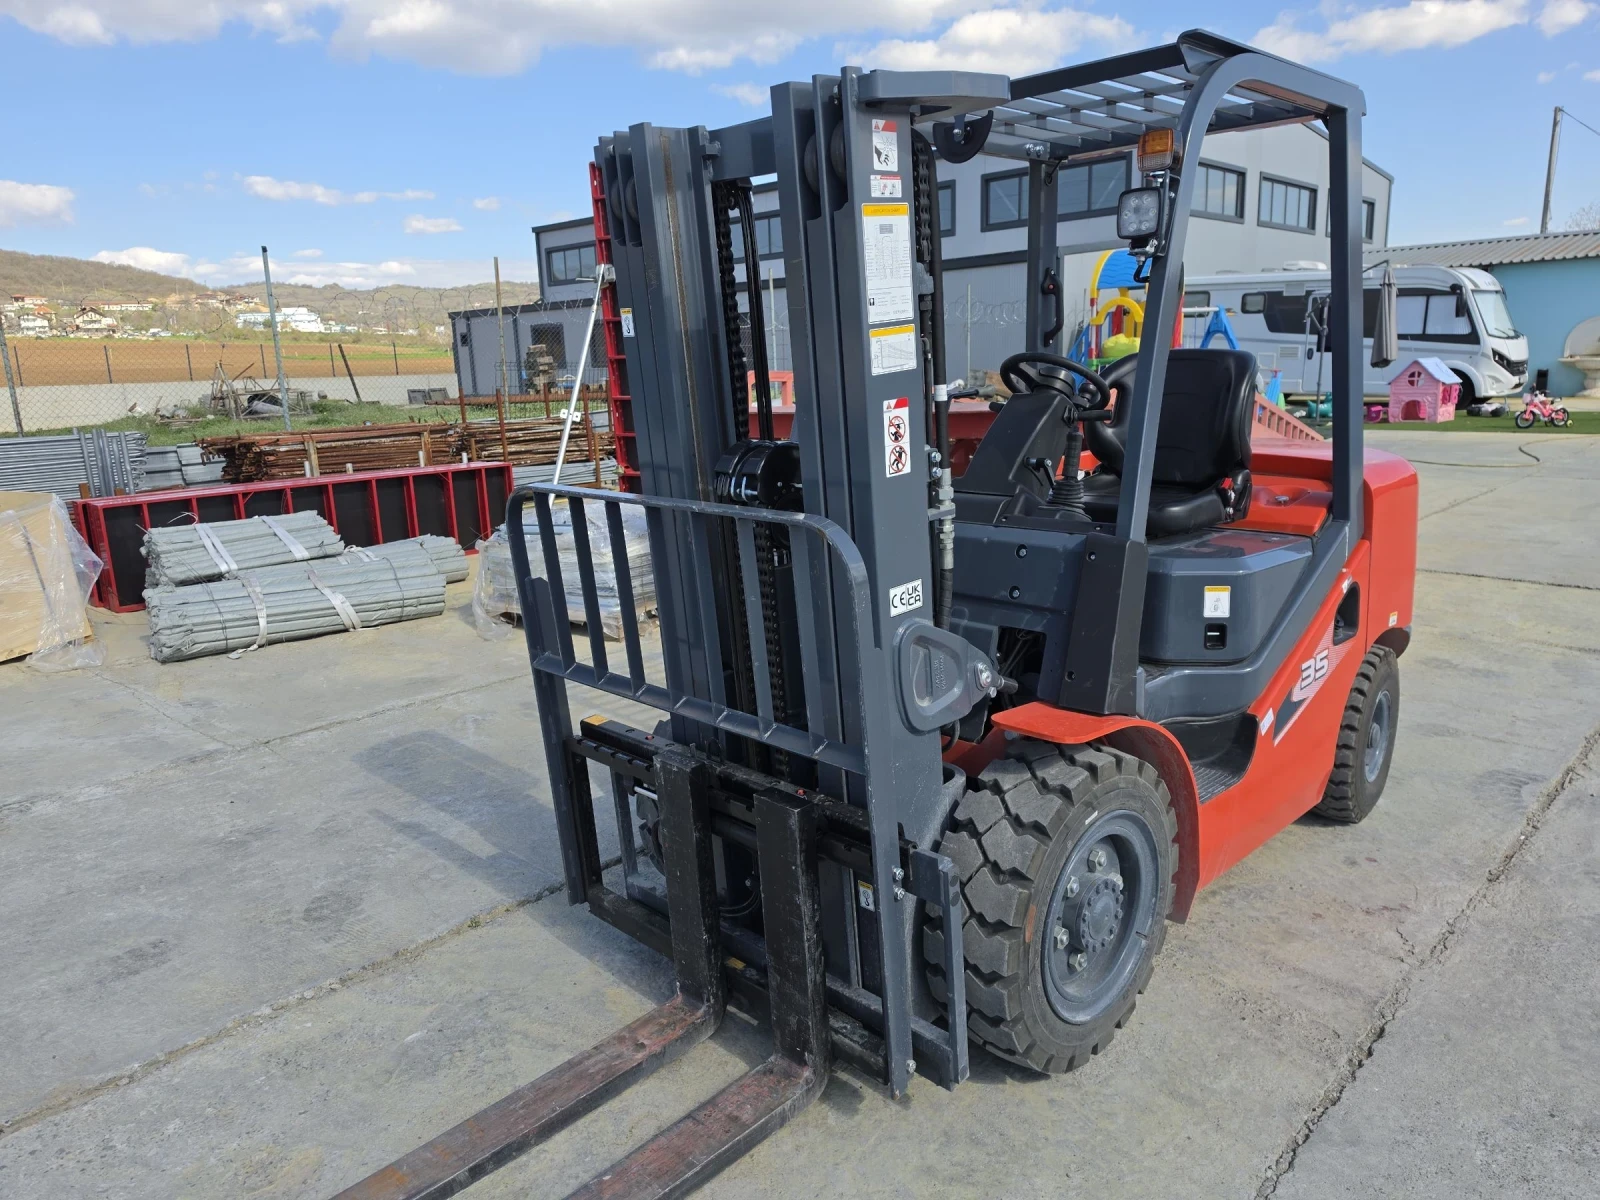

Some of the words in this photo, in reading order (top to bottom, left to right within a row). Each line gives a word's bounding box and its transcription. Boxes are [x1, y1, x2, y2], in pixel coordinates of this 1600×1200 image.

[907, 584, 920, 596] UK
[892, 591, 906, 608] CE
[908, 594, 921, 606] CA
[1300, 648, 1329, 690] 35
